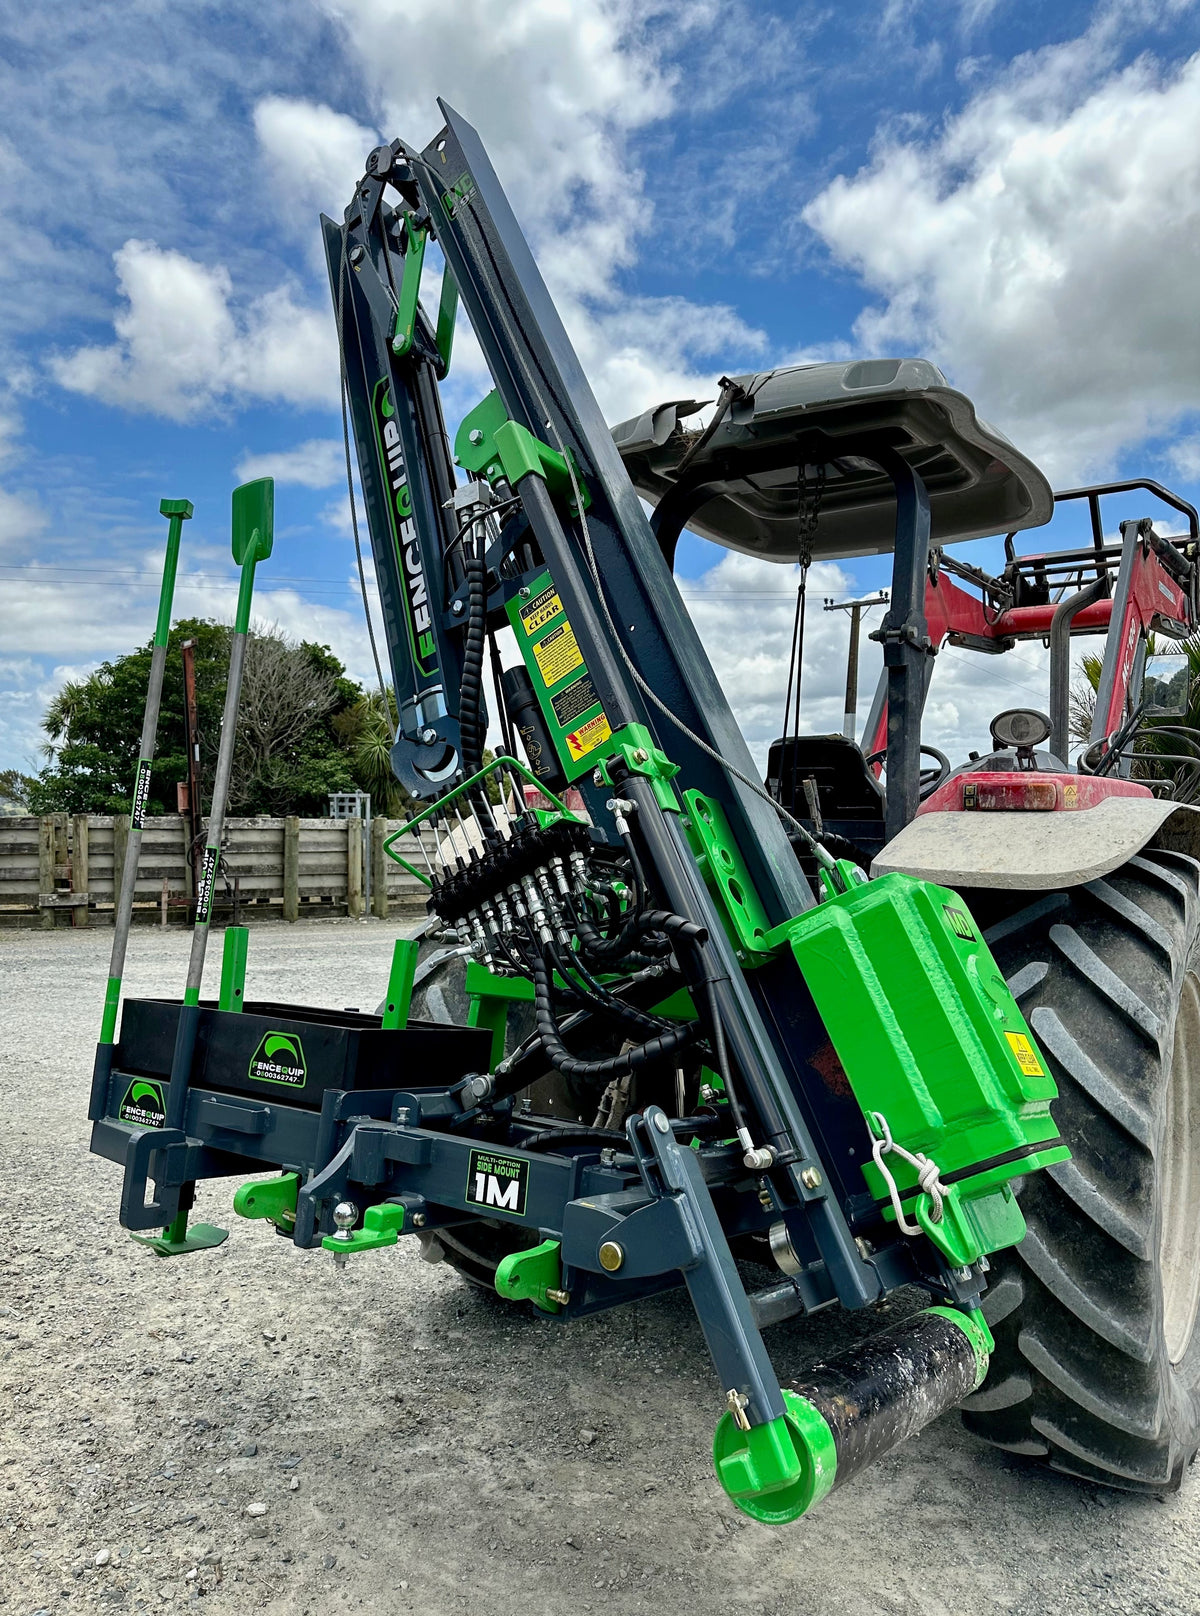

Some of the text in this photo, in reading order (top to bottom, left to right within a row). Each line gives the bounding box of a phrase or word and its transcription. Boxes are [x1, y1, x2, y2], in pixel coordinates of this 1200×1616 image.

[382, 419, 437, 660] FENCEQUIP
[532, 588, 555, 609] CAUTION
[529, 604, 559, 630] CLEAR
[578, 713, 606, 735] WARNING
[252, 1061, 304, 1077] FENCEQUIP
[121, 1105, 165, 1121] FENCEQUIP
[476, 1161, 520, 1179] SIDE MOUNT
[477, 1155, 521, 1169] MULTI-OPTION
[475, 1172, 520, 1210] 1M
